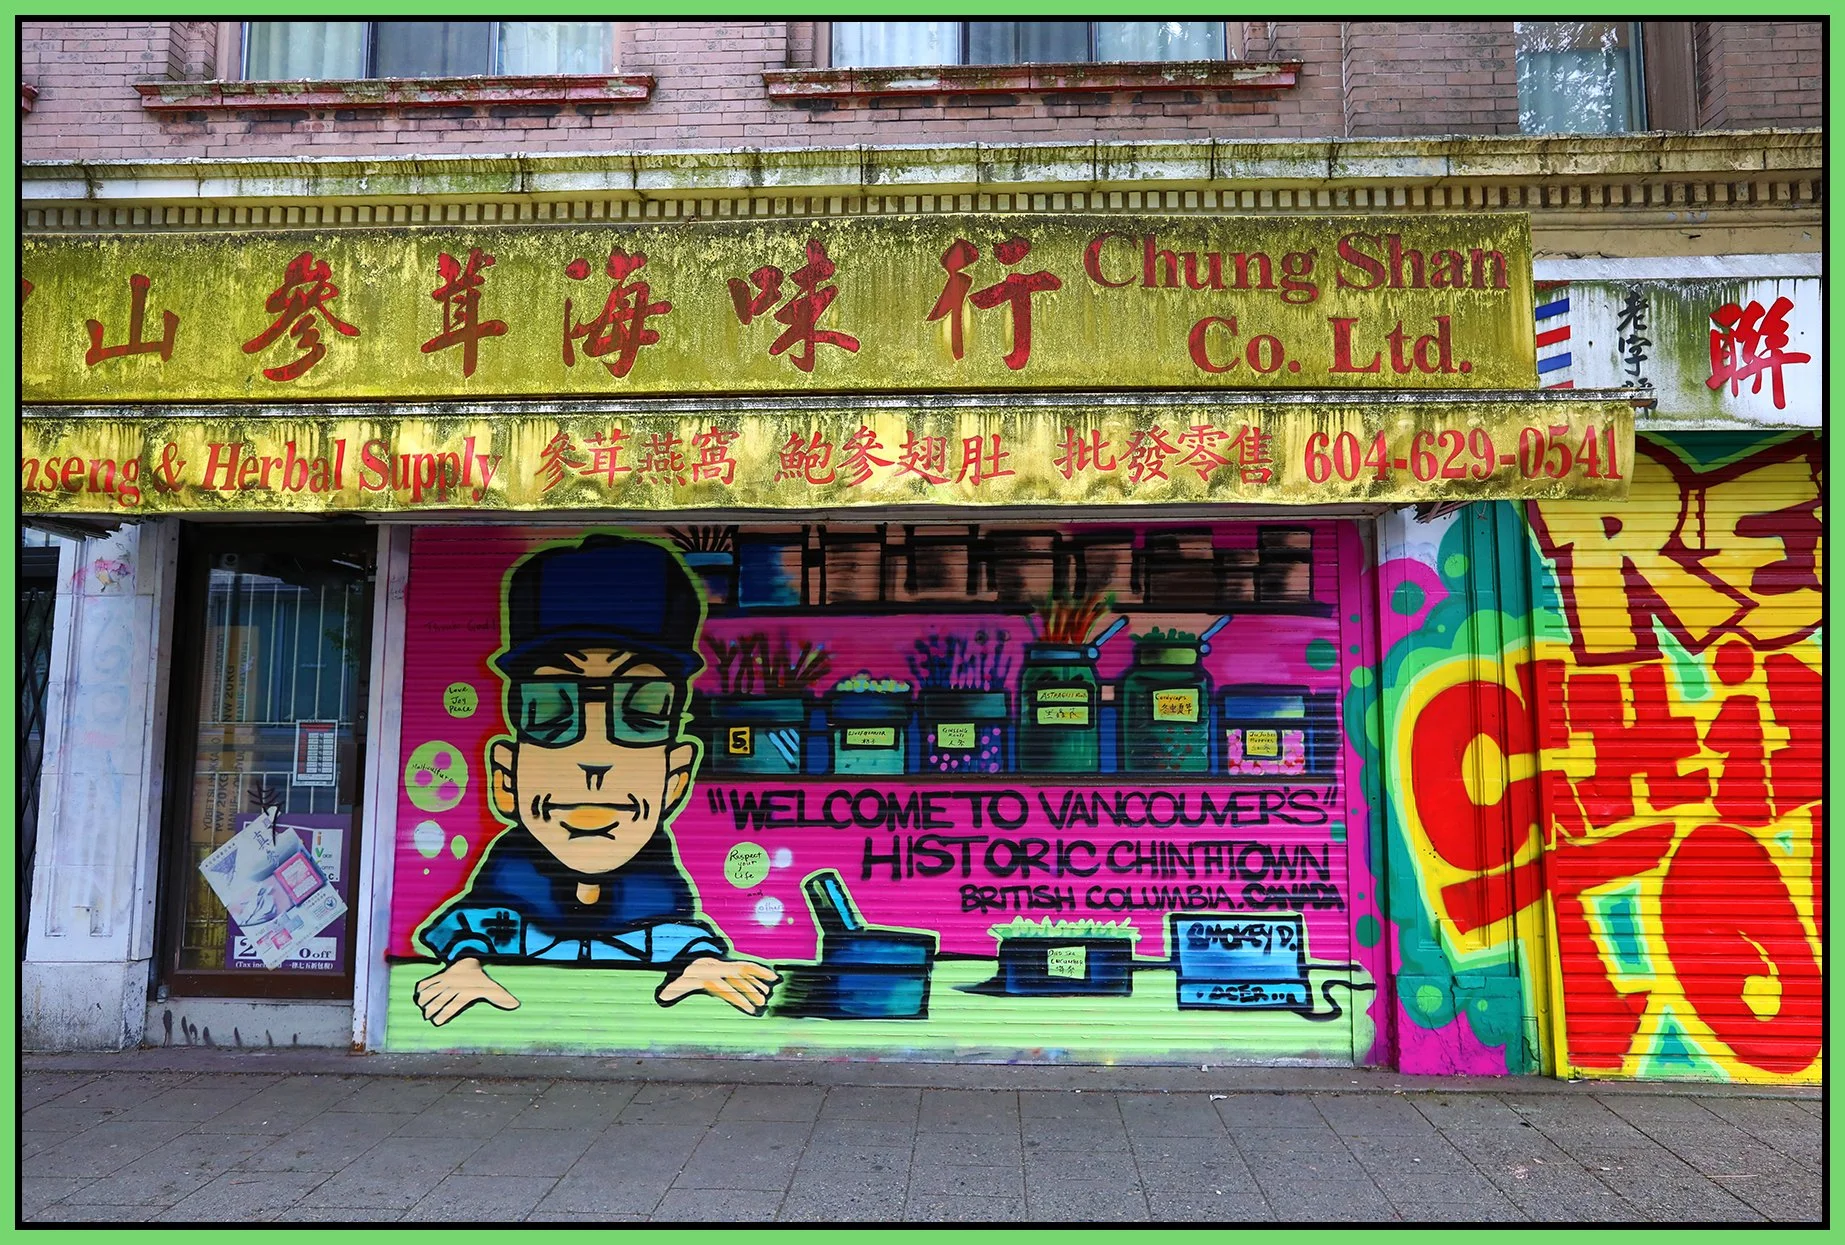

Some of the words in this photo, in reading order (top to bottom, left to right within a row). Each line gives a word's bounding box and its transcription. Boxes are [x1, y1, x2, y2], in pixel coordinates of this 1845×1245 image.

[1083, 231, 1320, 304] Chung
[1336, 232, 1510, 290] Shan
[22, 239, 1062, 382] 山參茸海味行
[1188, 316, 1301, 374] Co.
[1328, 315, 1473, 374] Ltd.
[153, 442, 187, 493] &
[201, 439, 346, 492] Herbal
[358, 436, 501, 502] Supply
[1053, 425, 1274, 485] 批發零售
[1303, 424, 1624, 485] 604-629-0541
[953, 789, 1029, 831] TO
[861, 834, 1101, 881] HISTORIC
[958, 884, 1076, 914] BRITISH
